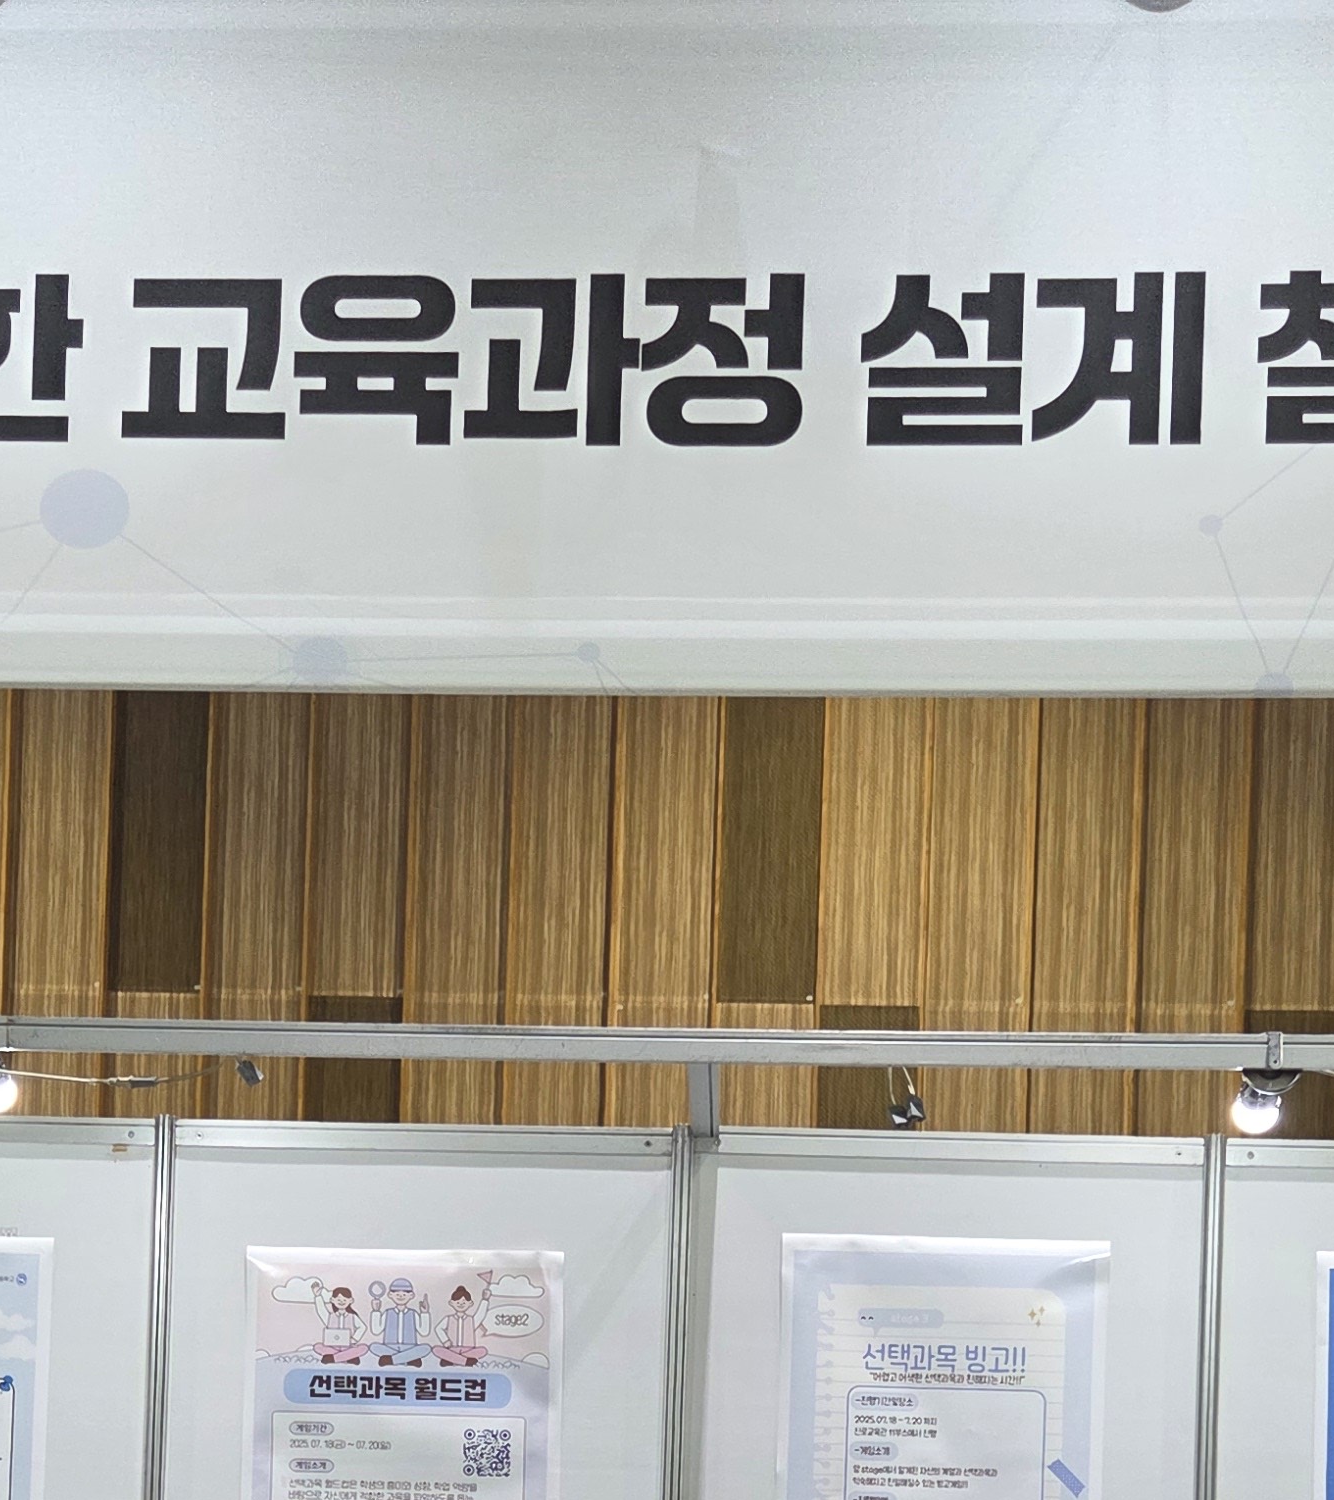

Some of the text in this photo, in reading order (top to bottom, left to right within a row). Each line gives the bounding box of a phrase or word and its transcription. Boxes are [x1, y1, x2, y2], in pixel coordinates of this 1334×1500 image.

[121, 271, 805, 447] 교육과정
[859, 271, 1207, 446] 설계
[494, 1313, 529, 1328] stage2
[862, 1342, 1027, 1374] 선택과목 빙고!!
[308, 1374, 487, 1403] 선택과목 월드컵
